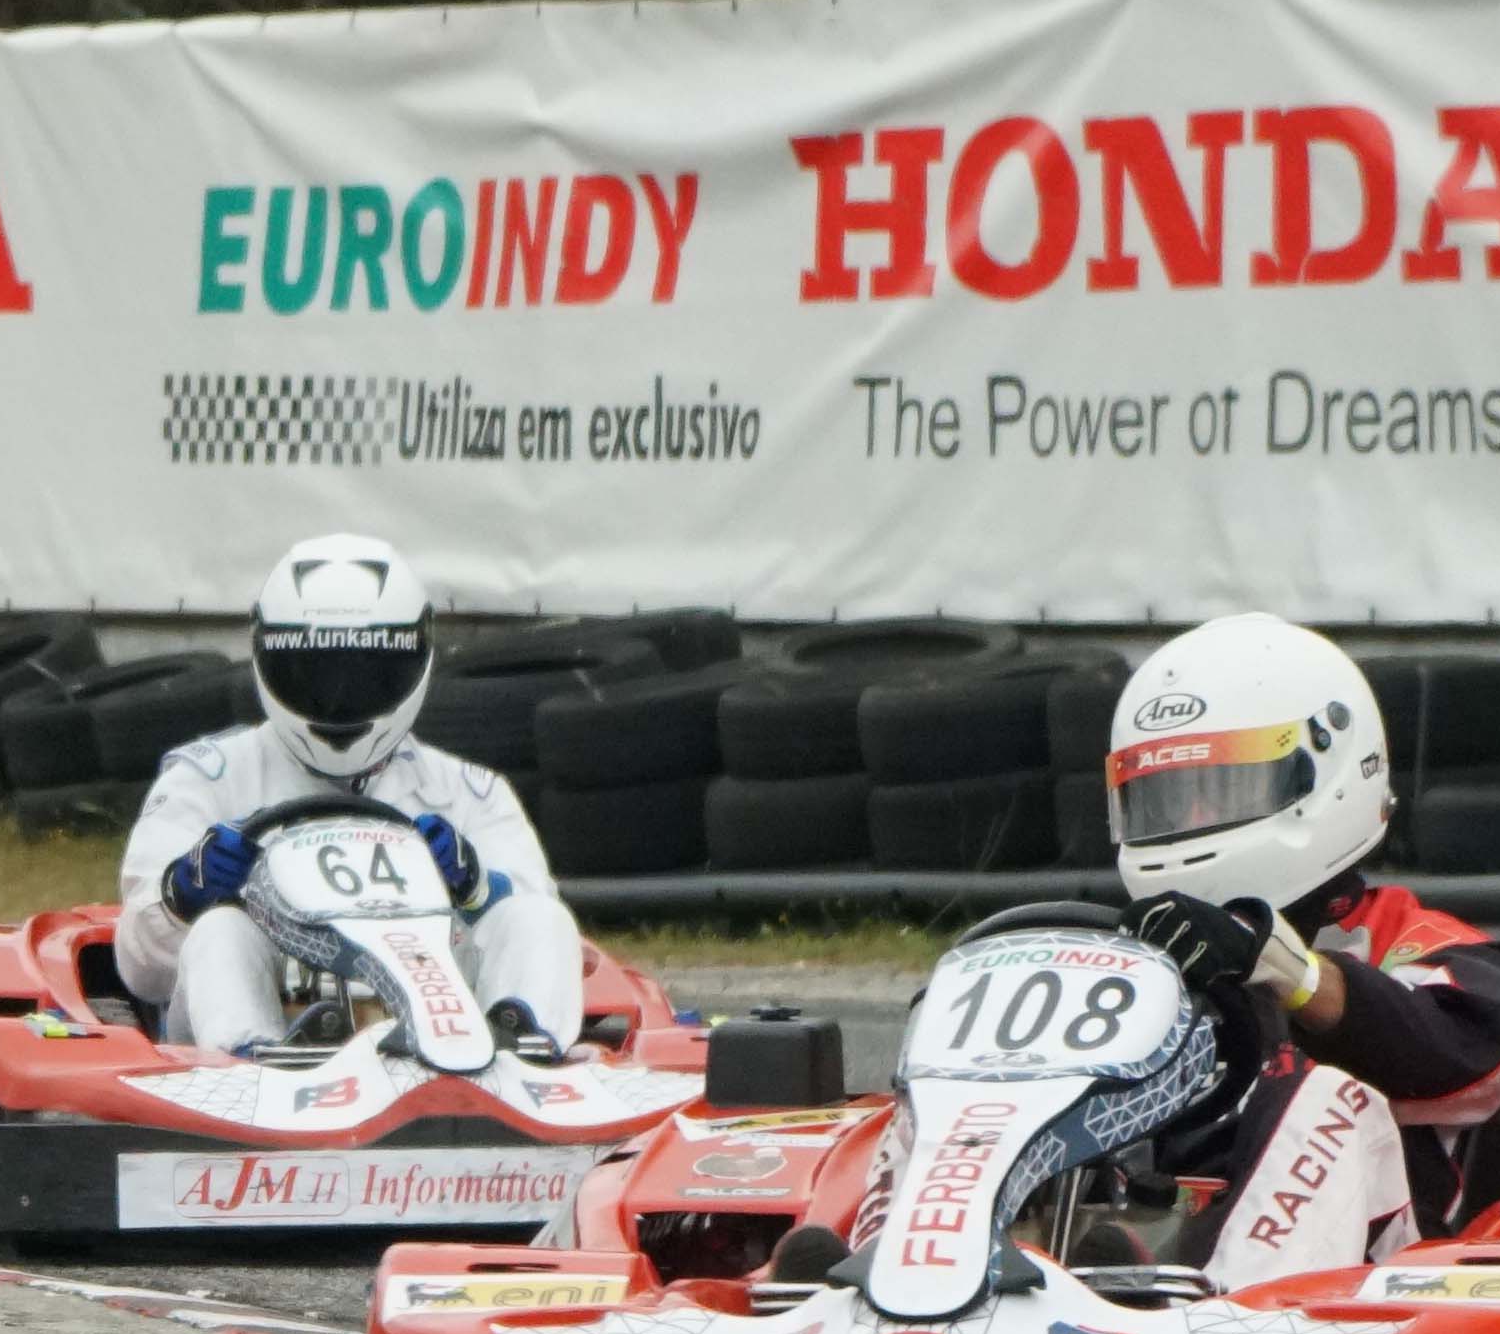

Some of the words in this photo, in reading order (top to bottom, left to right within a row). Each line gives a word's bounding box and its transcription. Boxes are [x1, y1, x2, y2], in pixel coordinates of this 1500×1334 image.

[197, 171, 700, 315] EUROINDY
[399, 374, 507, 461] Utiliza
[517, 404, 572, 461] em
[588, 371, 761, 461] exclusivo
[853, 375, 963, 461] The
[988, 375, 1167, 460] Power
[1189, 371, 1239, 456] of
[263, 627, 418, 651] www.funkart.net
[1147, 697, 1196, 720] Arai
[316, 842, 408, 897] 64
[961, 950, 1141, 972] EUROINDY
[948, 969, 1136, 1051] 108
[178, 1157, 299, 1212] AJM
[362, 1160, 567, 1218] Informática
[901, 1103, 1018, 1267] FERBERTO
[1247, 1078, 1369, 1250] RACING
[491, 1281, 609, 1307] eni
